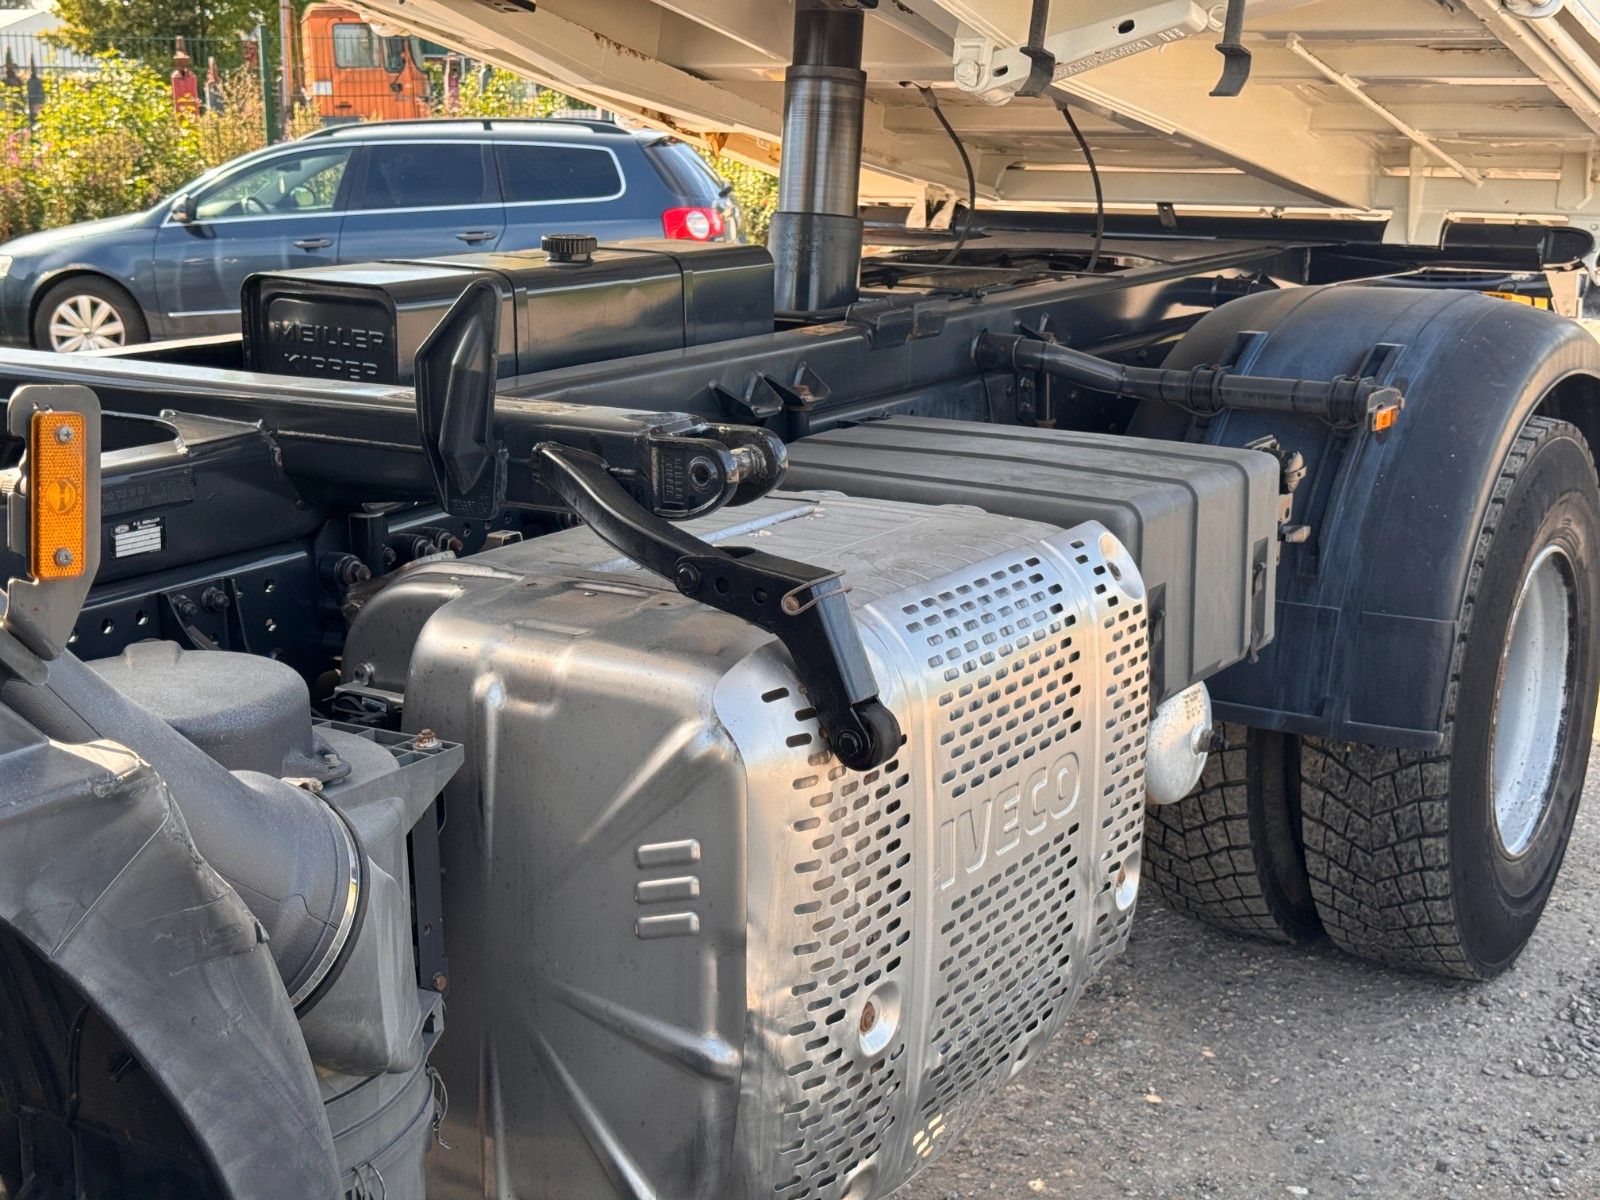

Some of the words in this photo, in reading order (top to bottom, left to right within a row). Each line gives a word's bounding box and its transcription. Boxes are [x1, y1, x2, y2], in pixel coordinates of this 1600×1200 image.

[269, 320, 385, 349] MEILLER
[283, 352, 378, 380] KIPPER
[939, 751, 1081, 890] IVECO
